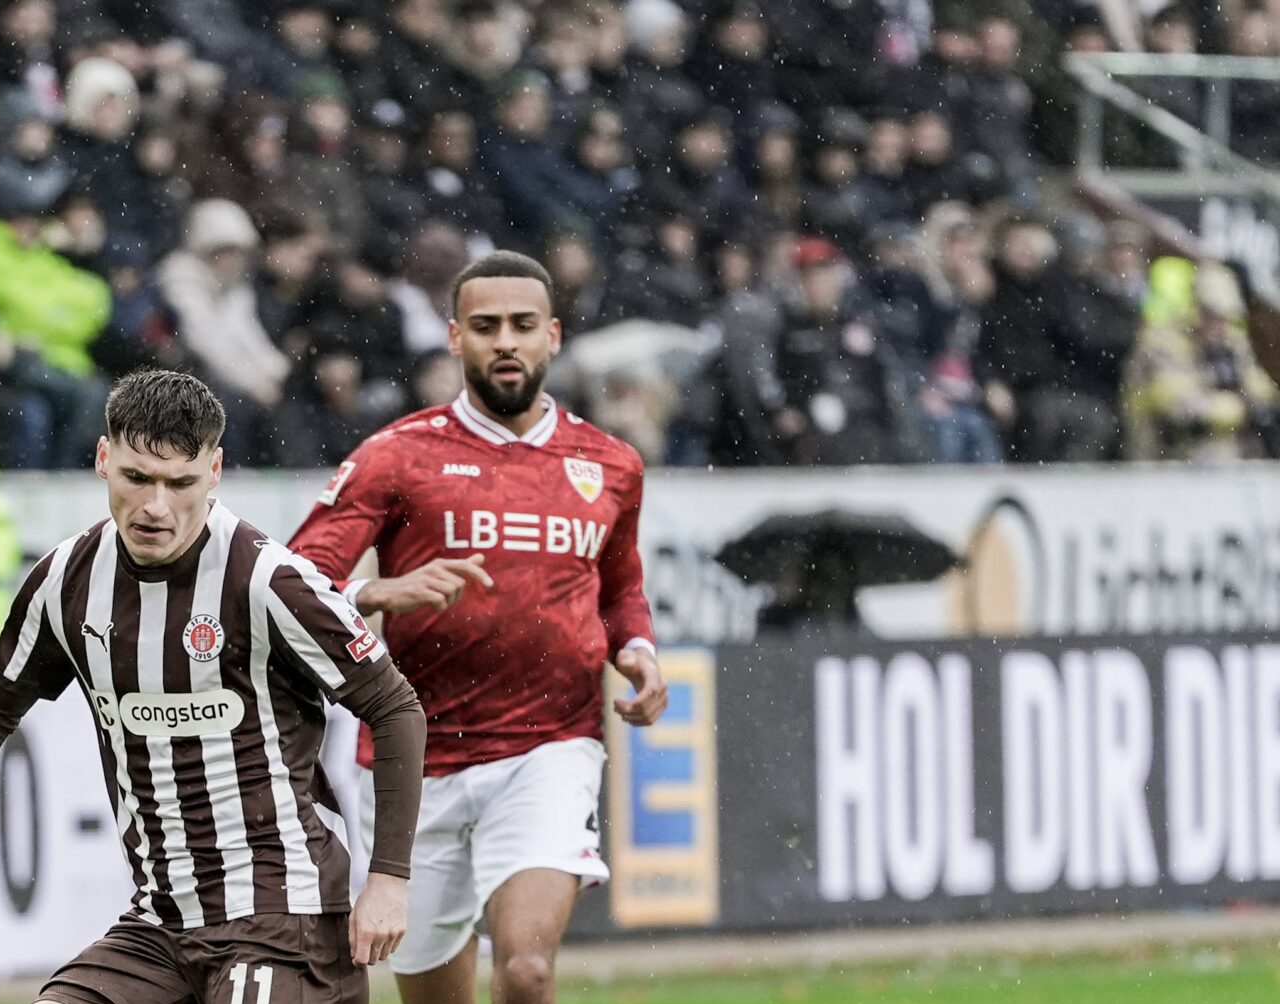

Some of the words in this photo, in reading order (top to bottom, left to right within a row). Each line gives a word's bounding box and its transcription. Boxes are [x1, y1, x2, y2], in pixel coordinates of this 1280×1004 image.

[442, 463, 481, 477] JAKO
[194, 652, 212, 660] 1910
[131, 702, 229, 728] congstar
[816, 651, 995, 900] HOL
[1001, 649, 1160, 893] DIR
